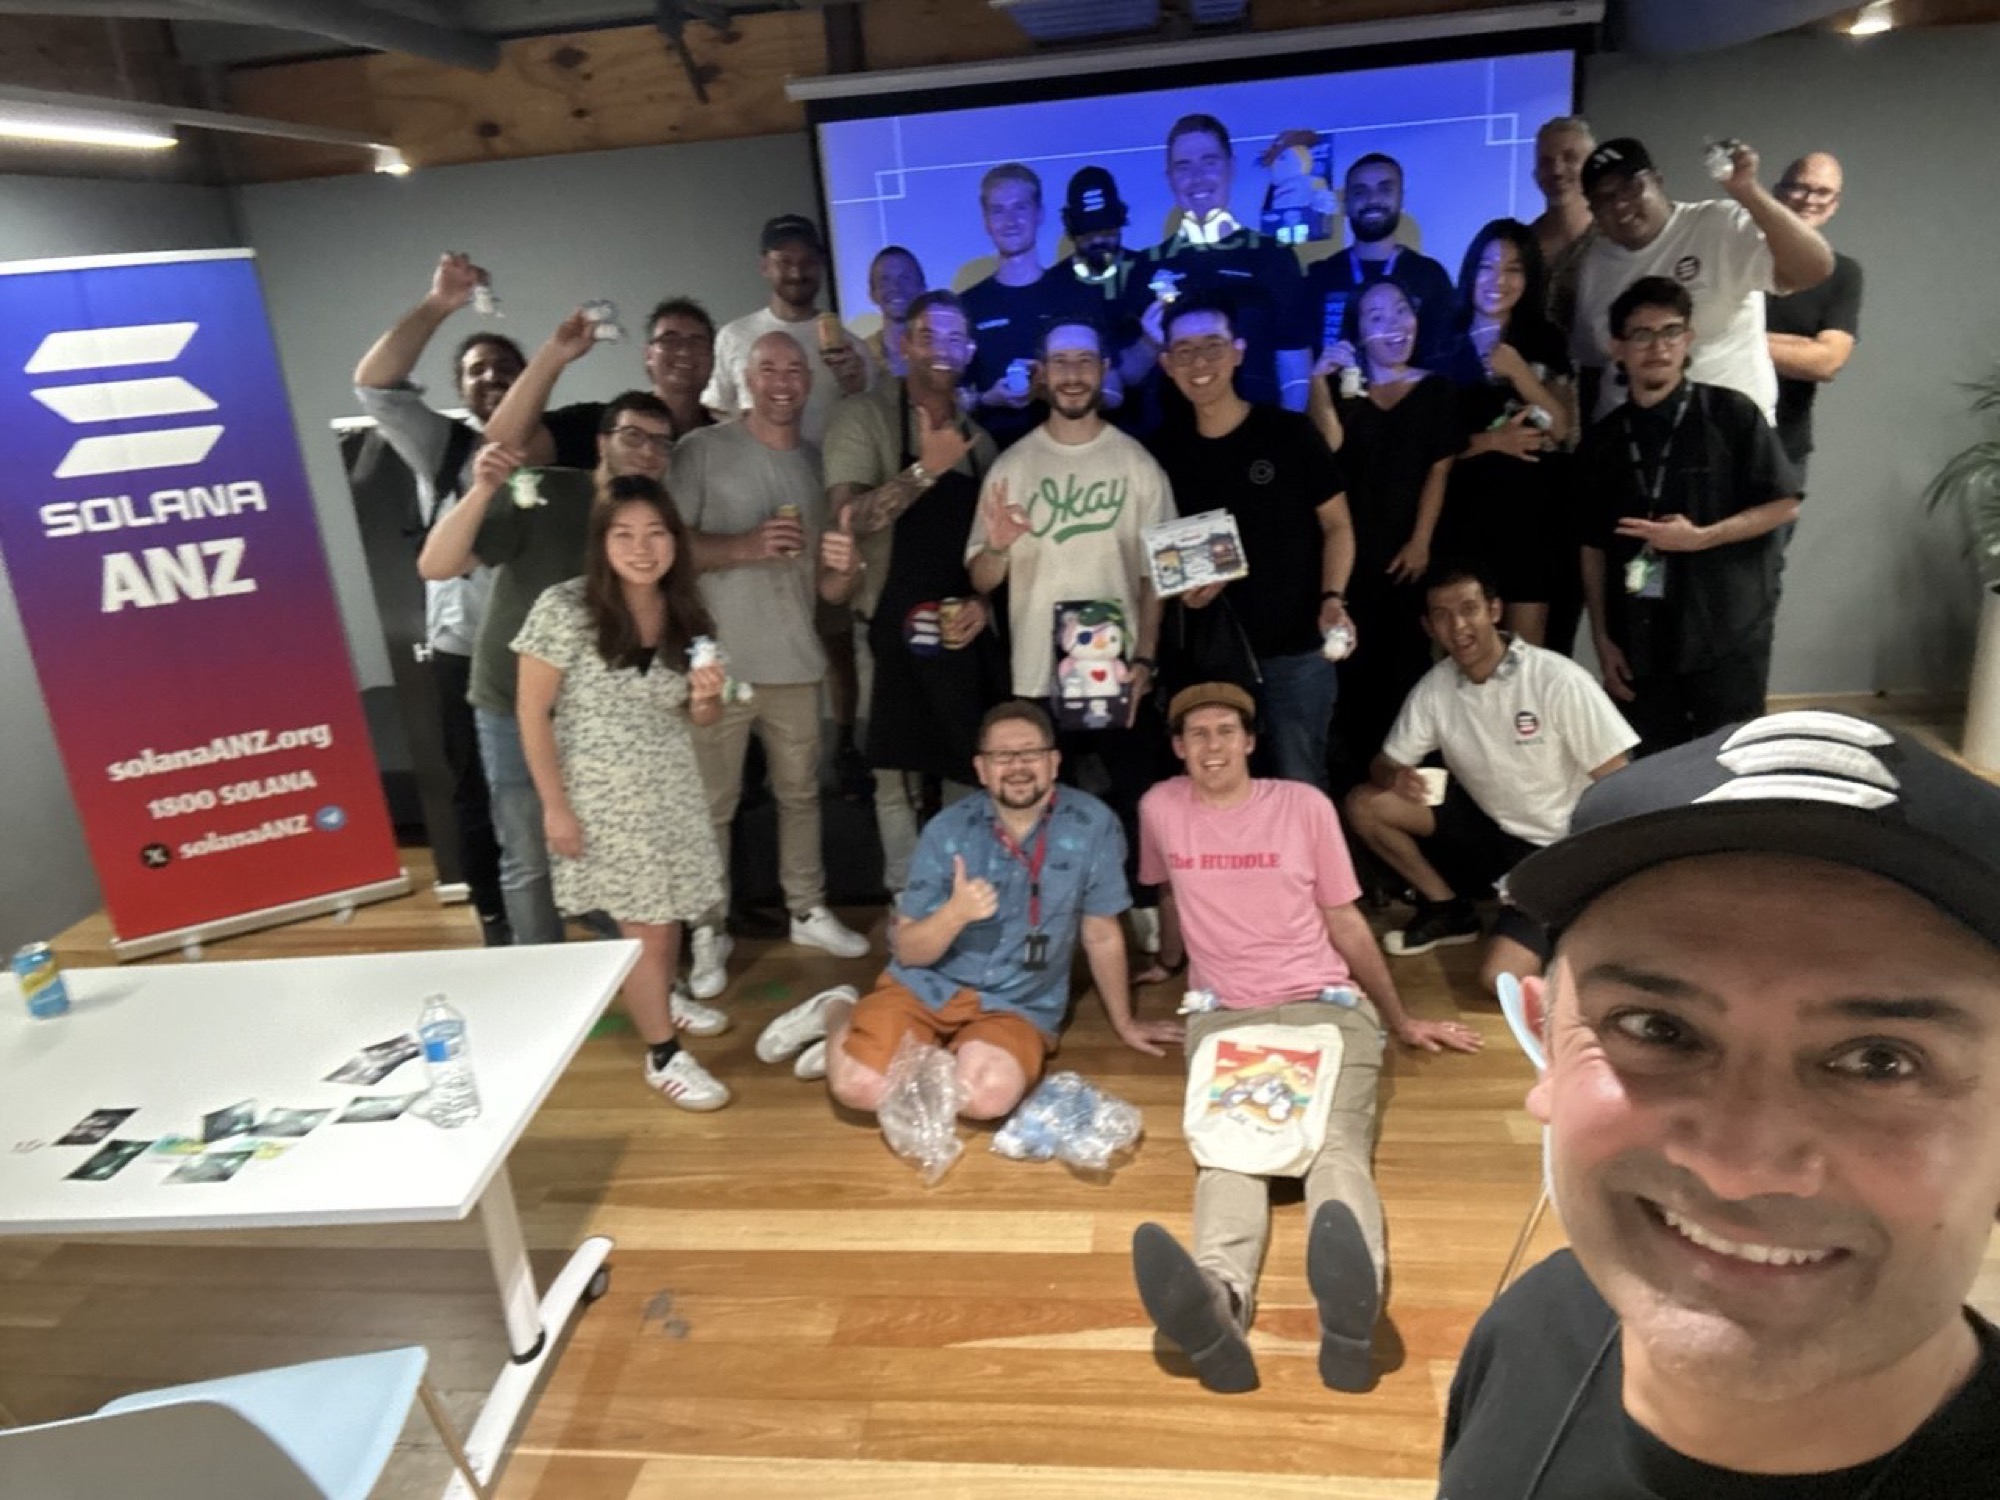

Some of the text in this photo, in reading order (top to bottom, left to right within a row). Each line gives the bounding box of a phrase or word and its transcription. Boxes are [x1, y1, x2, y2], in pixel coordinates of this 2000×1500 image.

[39, 480, 268, 538] SOLANA
[1027, 473, 1128, 544] Okay
[101, 537, 258, 613] ANZ
[106, 723, 333, 782] solanaANZ.org
[218, 769, 318, 806] SOLANA
[178, 813, 313, 860] solanaANZ
[1200, 851, 1282, 871] HUDDLE
